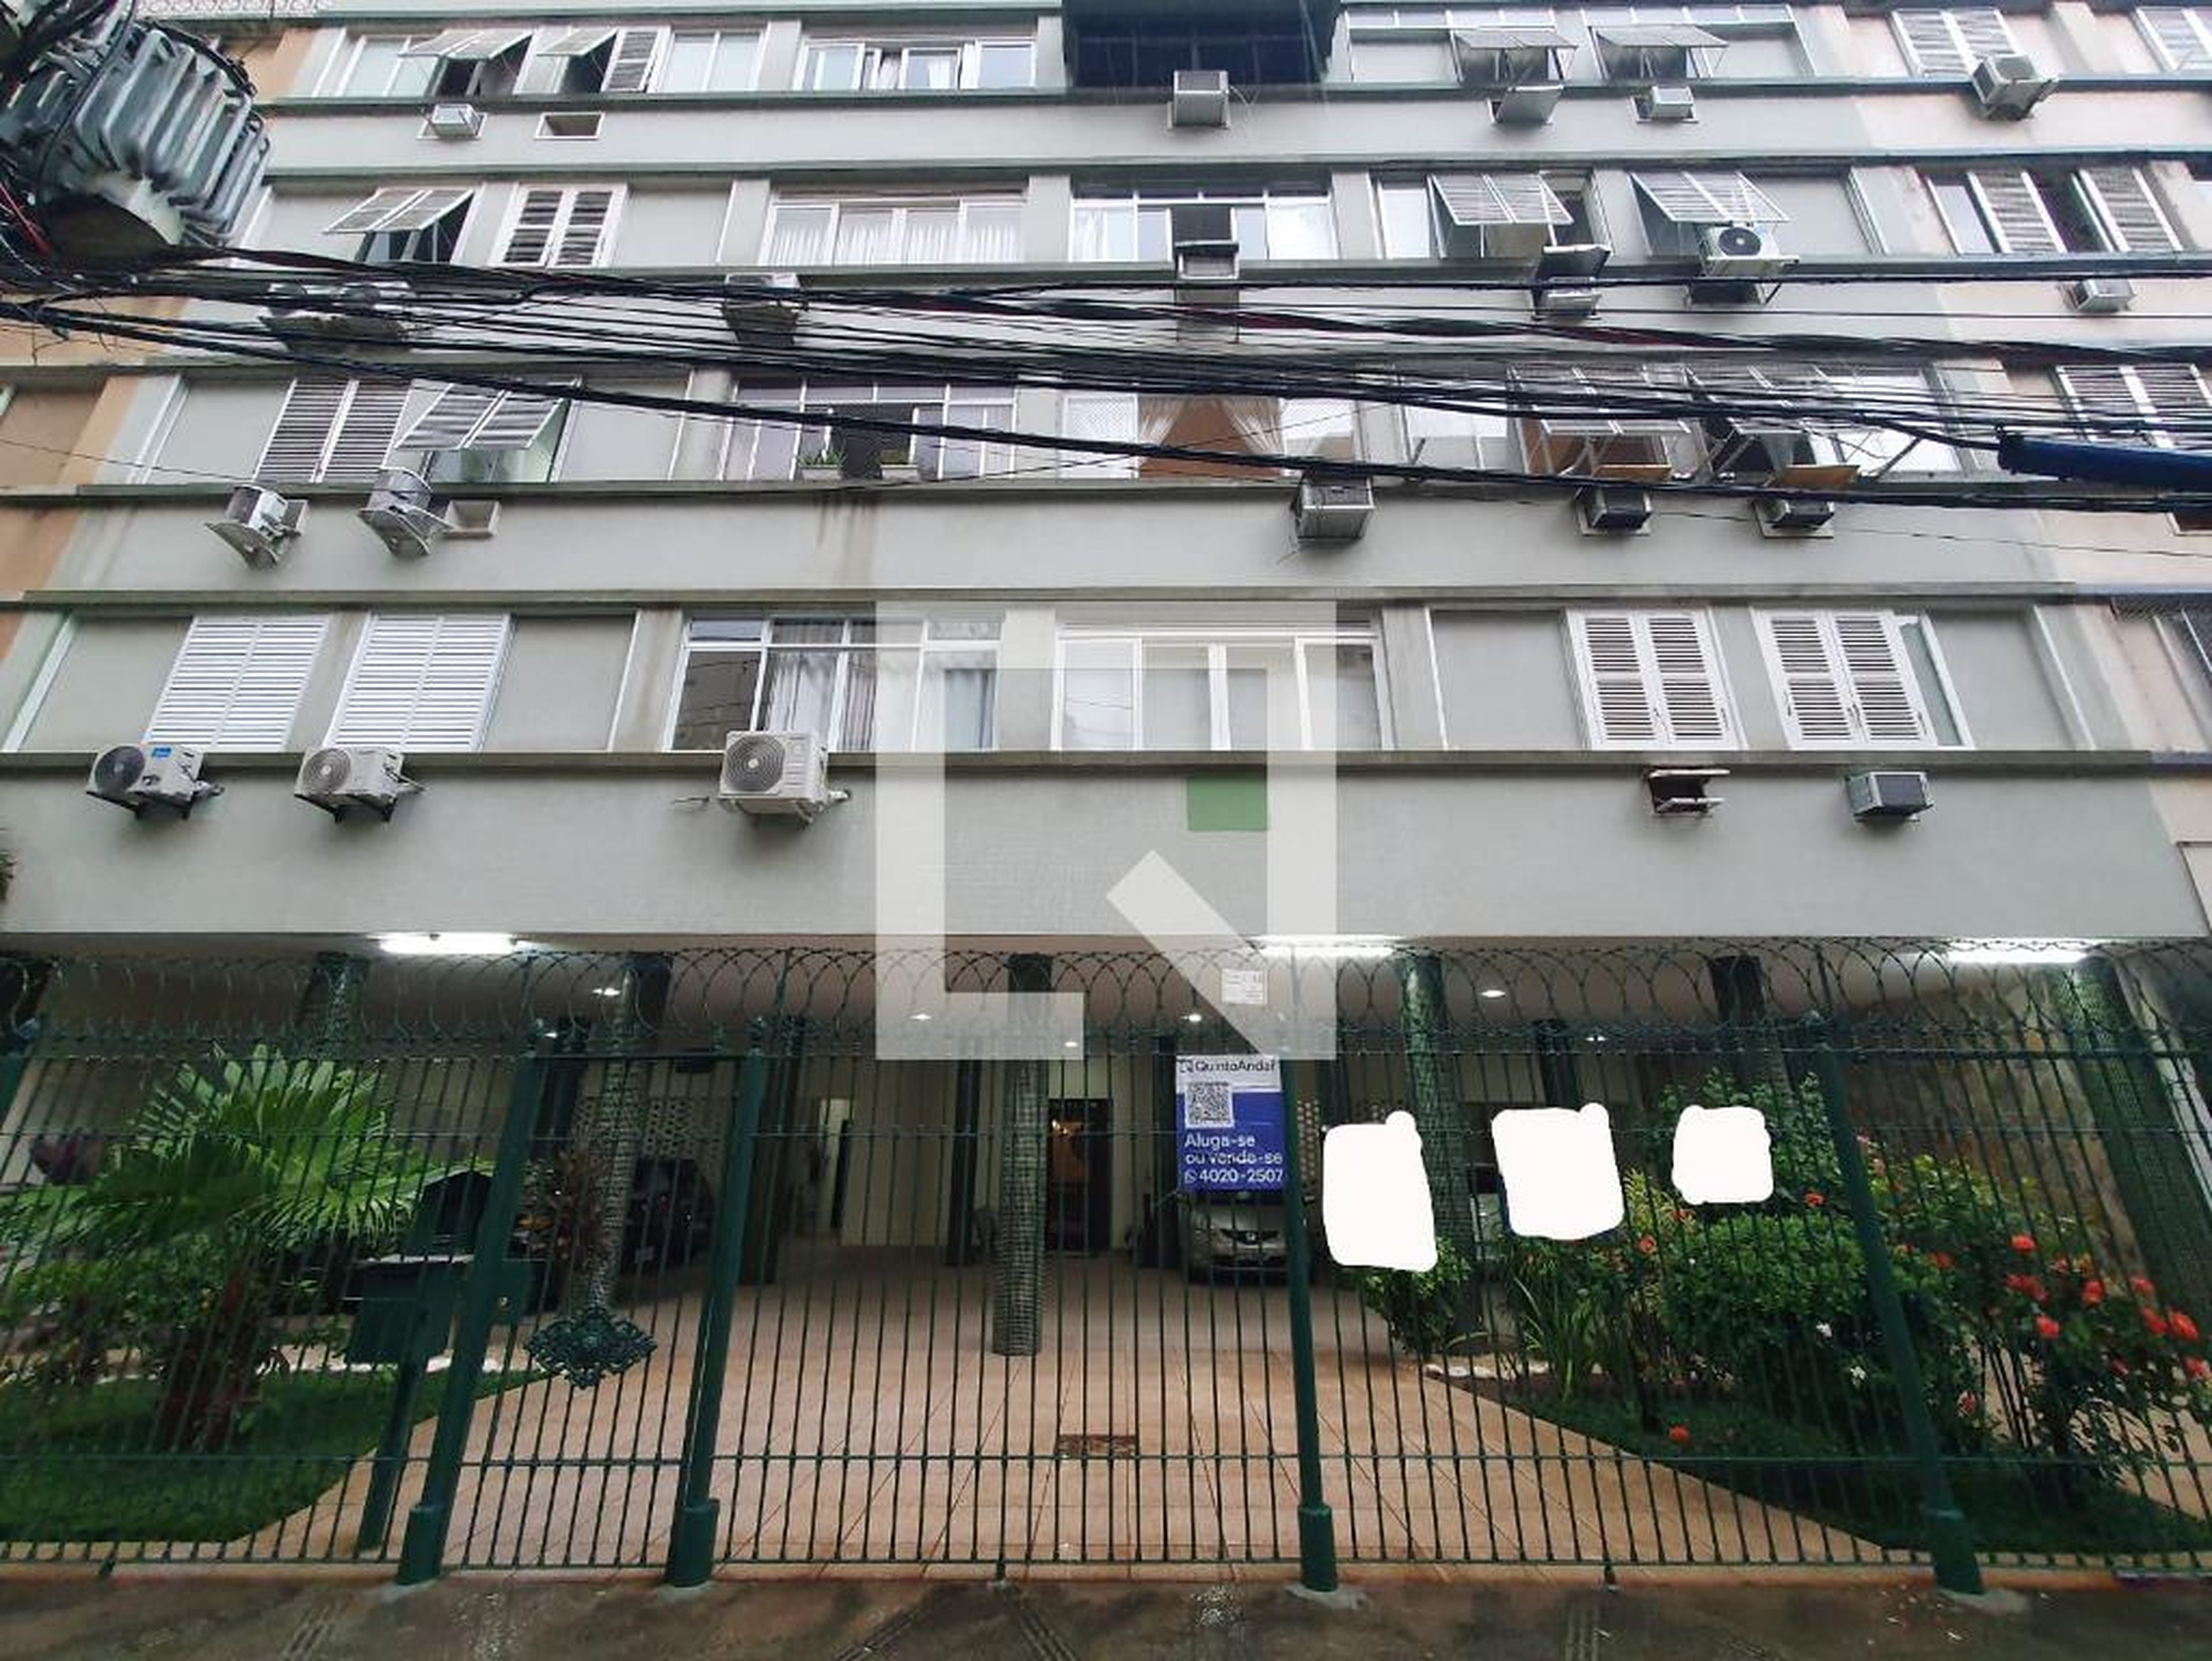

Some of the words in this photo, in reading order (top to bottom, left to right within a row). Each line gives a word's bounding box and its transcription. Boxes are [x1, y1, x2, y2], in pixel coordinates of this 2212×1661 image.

[1195, 1060, 1275, 1072] QuntoAndar
[1184, 1133, 1255, 1150] Aluga-se
[1185, 1153, 1205, 1164] ou
[1199, 1169, 1283, 1182] 4020-2507
